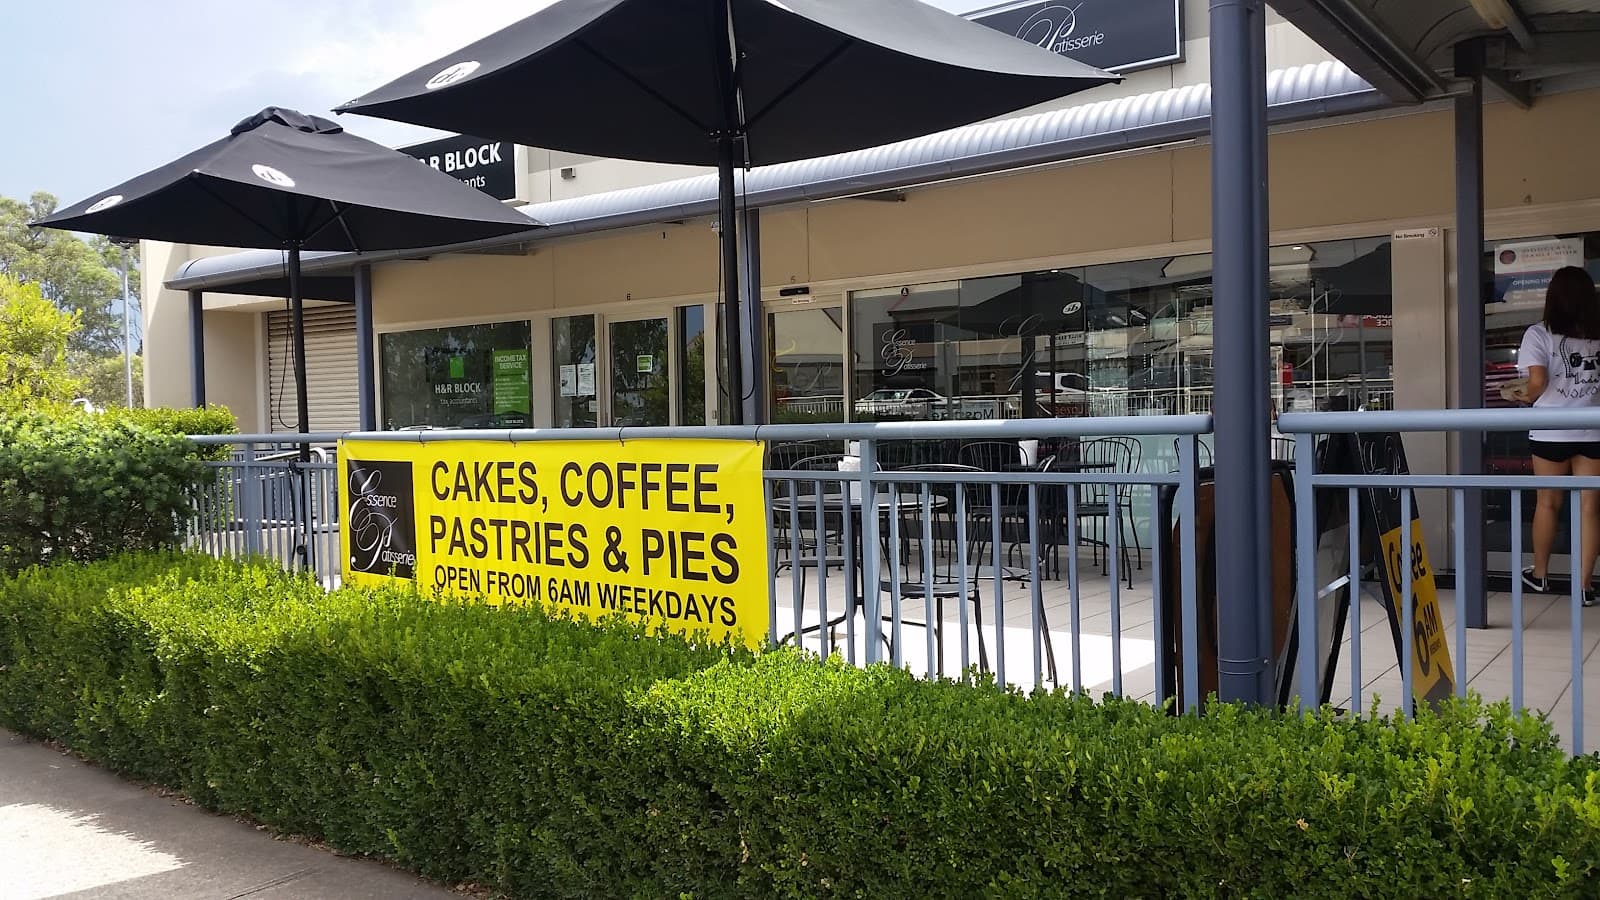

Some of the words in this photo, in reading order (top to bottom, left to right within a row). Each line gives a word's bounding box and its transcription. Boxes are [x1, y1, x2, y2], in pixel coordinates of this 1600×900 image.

[1015, 2, 1105, 53] Patisserie
[444, 142, 502, 172] BLOCK
[434, 383, 453, 394] H&R
[454, 382, 481, 393] BLOCK
[500, 361, 522, 369] SERVICE
[431, 461, 548, 514] CAKES,
[560, 461, 735, 525] COFFEE,
[350, 512, 415, 572] Patisserie
[430, 515, 589, 569] PASTRIES
[603, 525, 630, 574] &
[641, 528, 740, 585] PIES
[434, 564, 480, 592] OPEN
[487, 570, 542, 601] FROM
[548, 577, 591, 607] 6AM
[596, 582, 738, 627] WEEKDAYS
